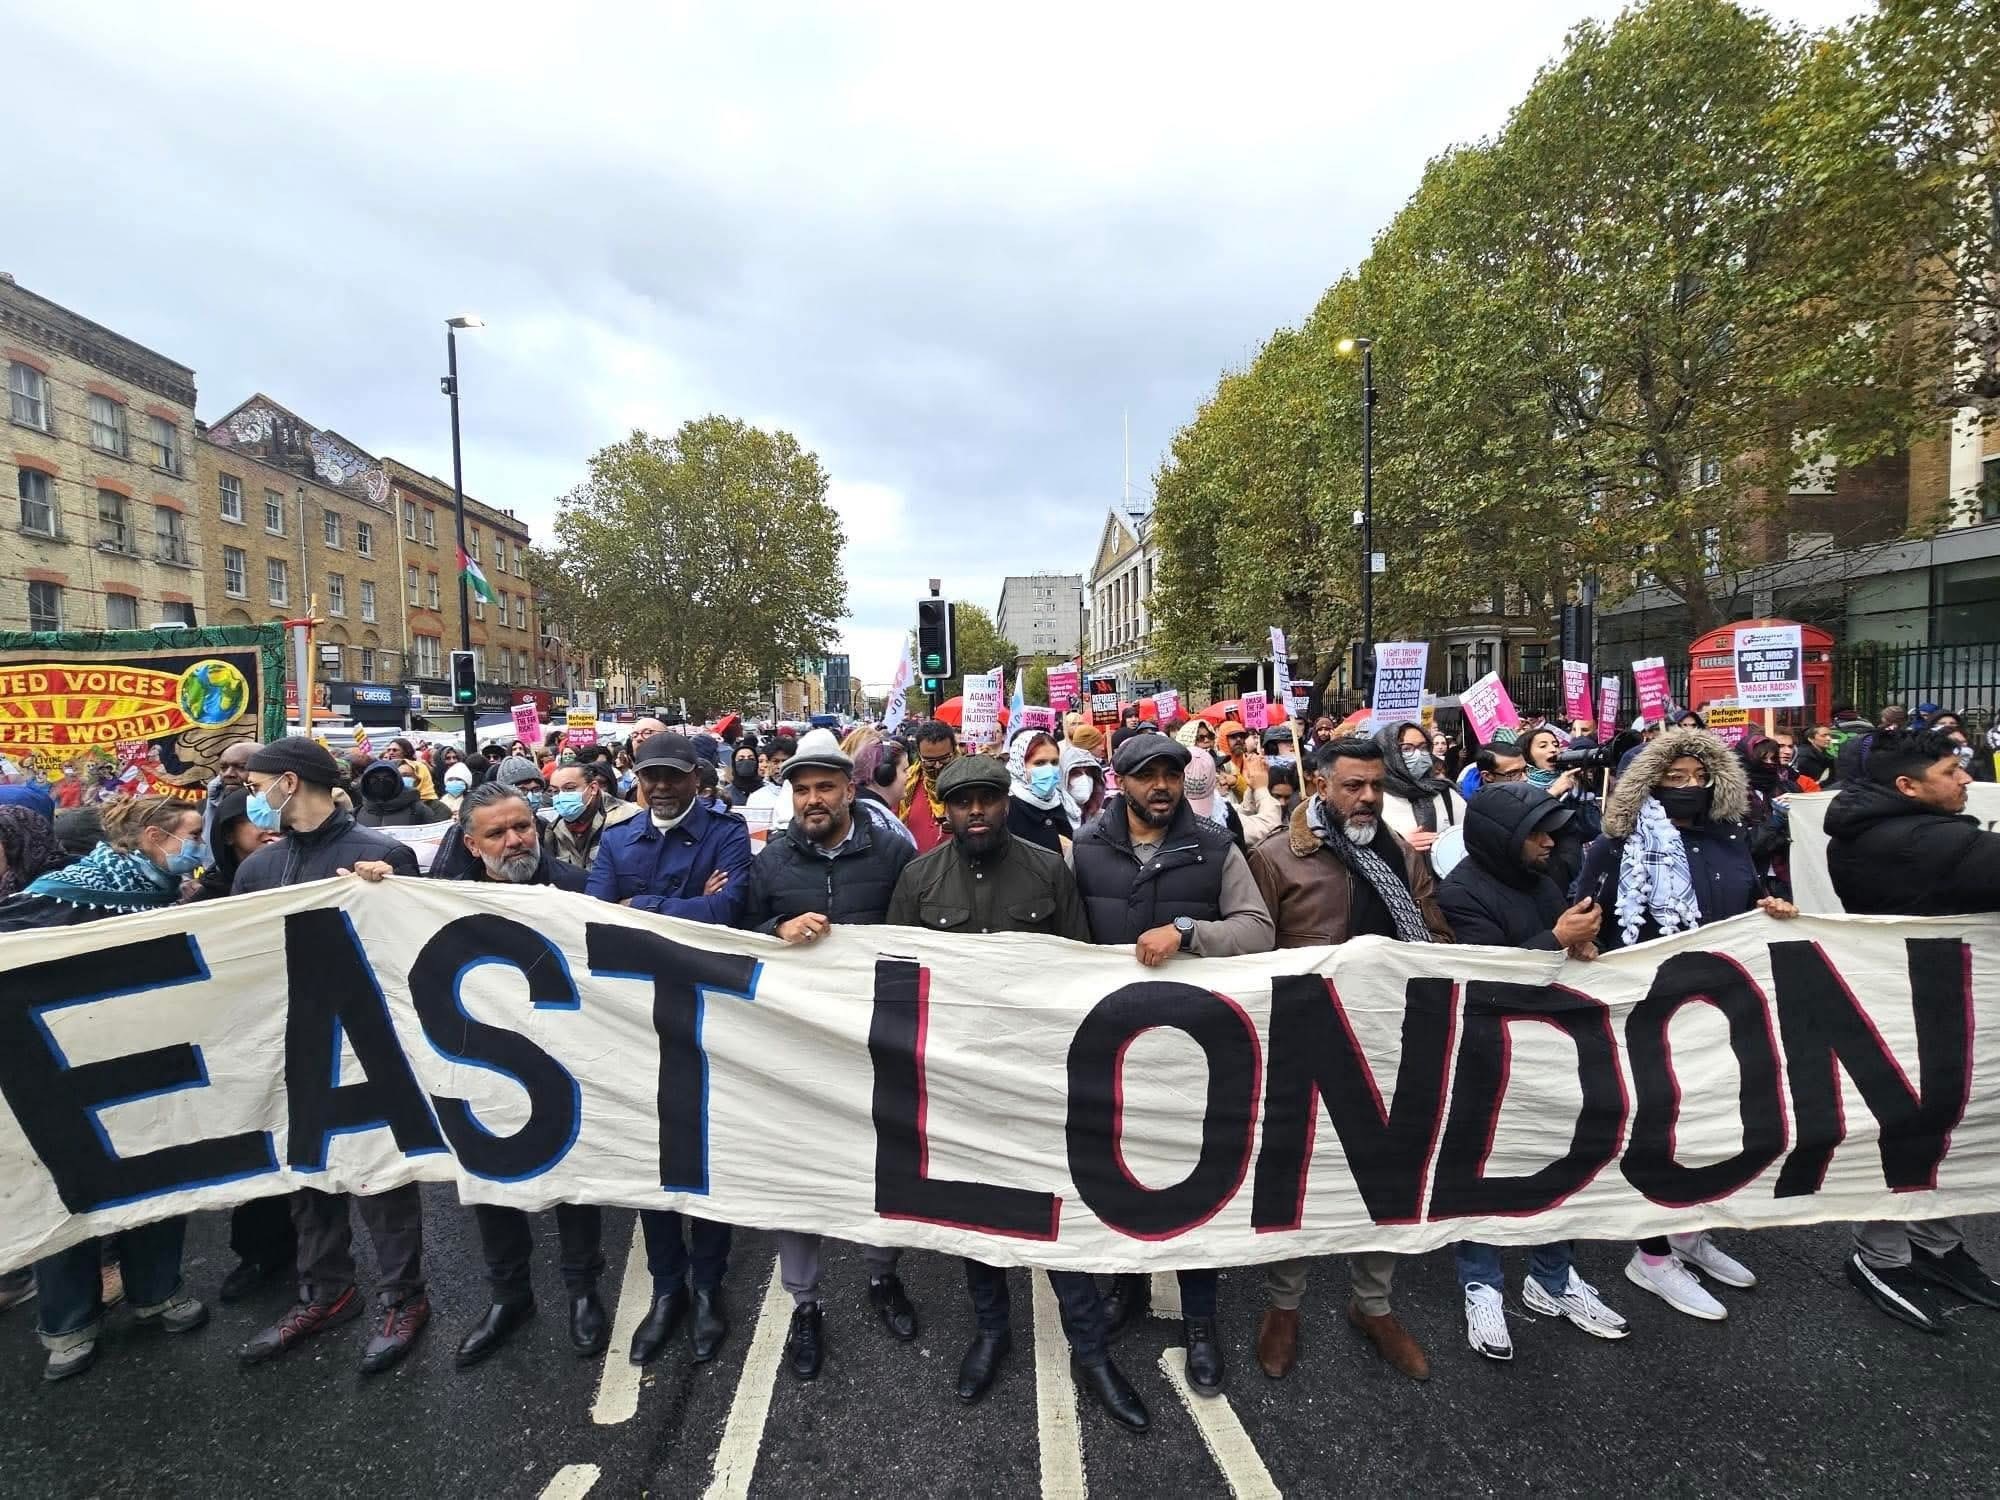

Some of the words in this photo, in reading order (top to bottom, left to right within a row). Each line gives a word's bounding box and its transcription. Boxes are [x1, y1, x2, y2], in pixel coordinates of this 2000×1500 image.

[1383, 648, 1400, 657] FIGHT
[1402, 648, 1422, 657] TRUMP
[1741, 651, 1765, 661] JOBS,
[1765, 650, 1794, 660] HOMES
[1391, 657, 1418, 666] STARMER
[1746, 663, 1753, 671] &
[1753, 660, 1790, 671] SERVICES
[1380, 670, 1392, 679] NO
[1393, 669, 1403, 679] TO
[1404, 669, 1421, 679] WAR
[1752, 671, 1769, 681] FOR
[63, 672, 166, 696] VOICES
[1380, 679, 1420, 692] RACISM
[1741, 684, 1768, 692] SMASH
[1769, 682, 1797, 691] RACISM
[363, 691, 391, 702] GREGGS
[969, 692, 998, 702] AGAINST
[1091, 693, 1117, 702] REFUGEES
[1401, 691, 1418, 699] CHAOS
[1092, 702, 1118, 711] WELCOME
[1379, 699, 1418, 708] CAPITALISM
[1026, 712, 1049, 722] SMASH
[1711, 708, 1747, 717] Refugees
[568, 714, 595, 722] Refugees
[66, 713, 171, 744] WORLD
[1711, 727, 1728, 736] Stop
[1729, 726, 1743, 734] the
[0, 906, 765, 1216] EAST
[868, 937, 1976, 1242] LONDON
